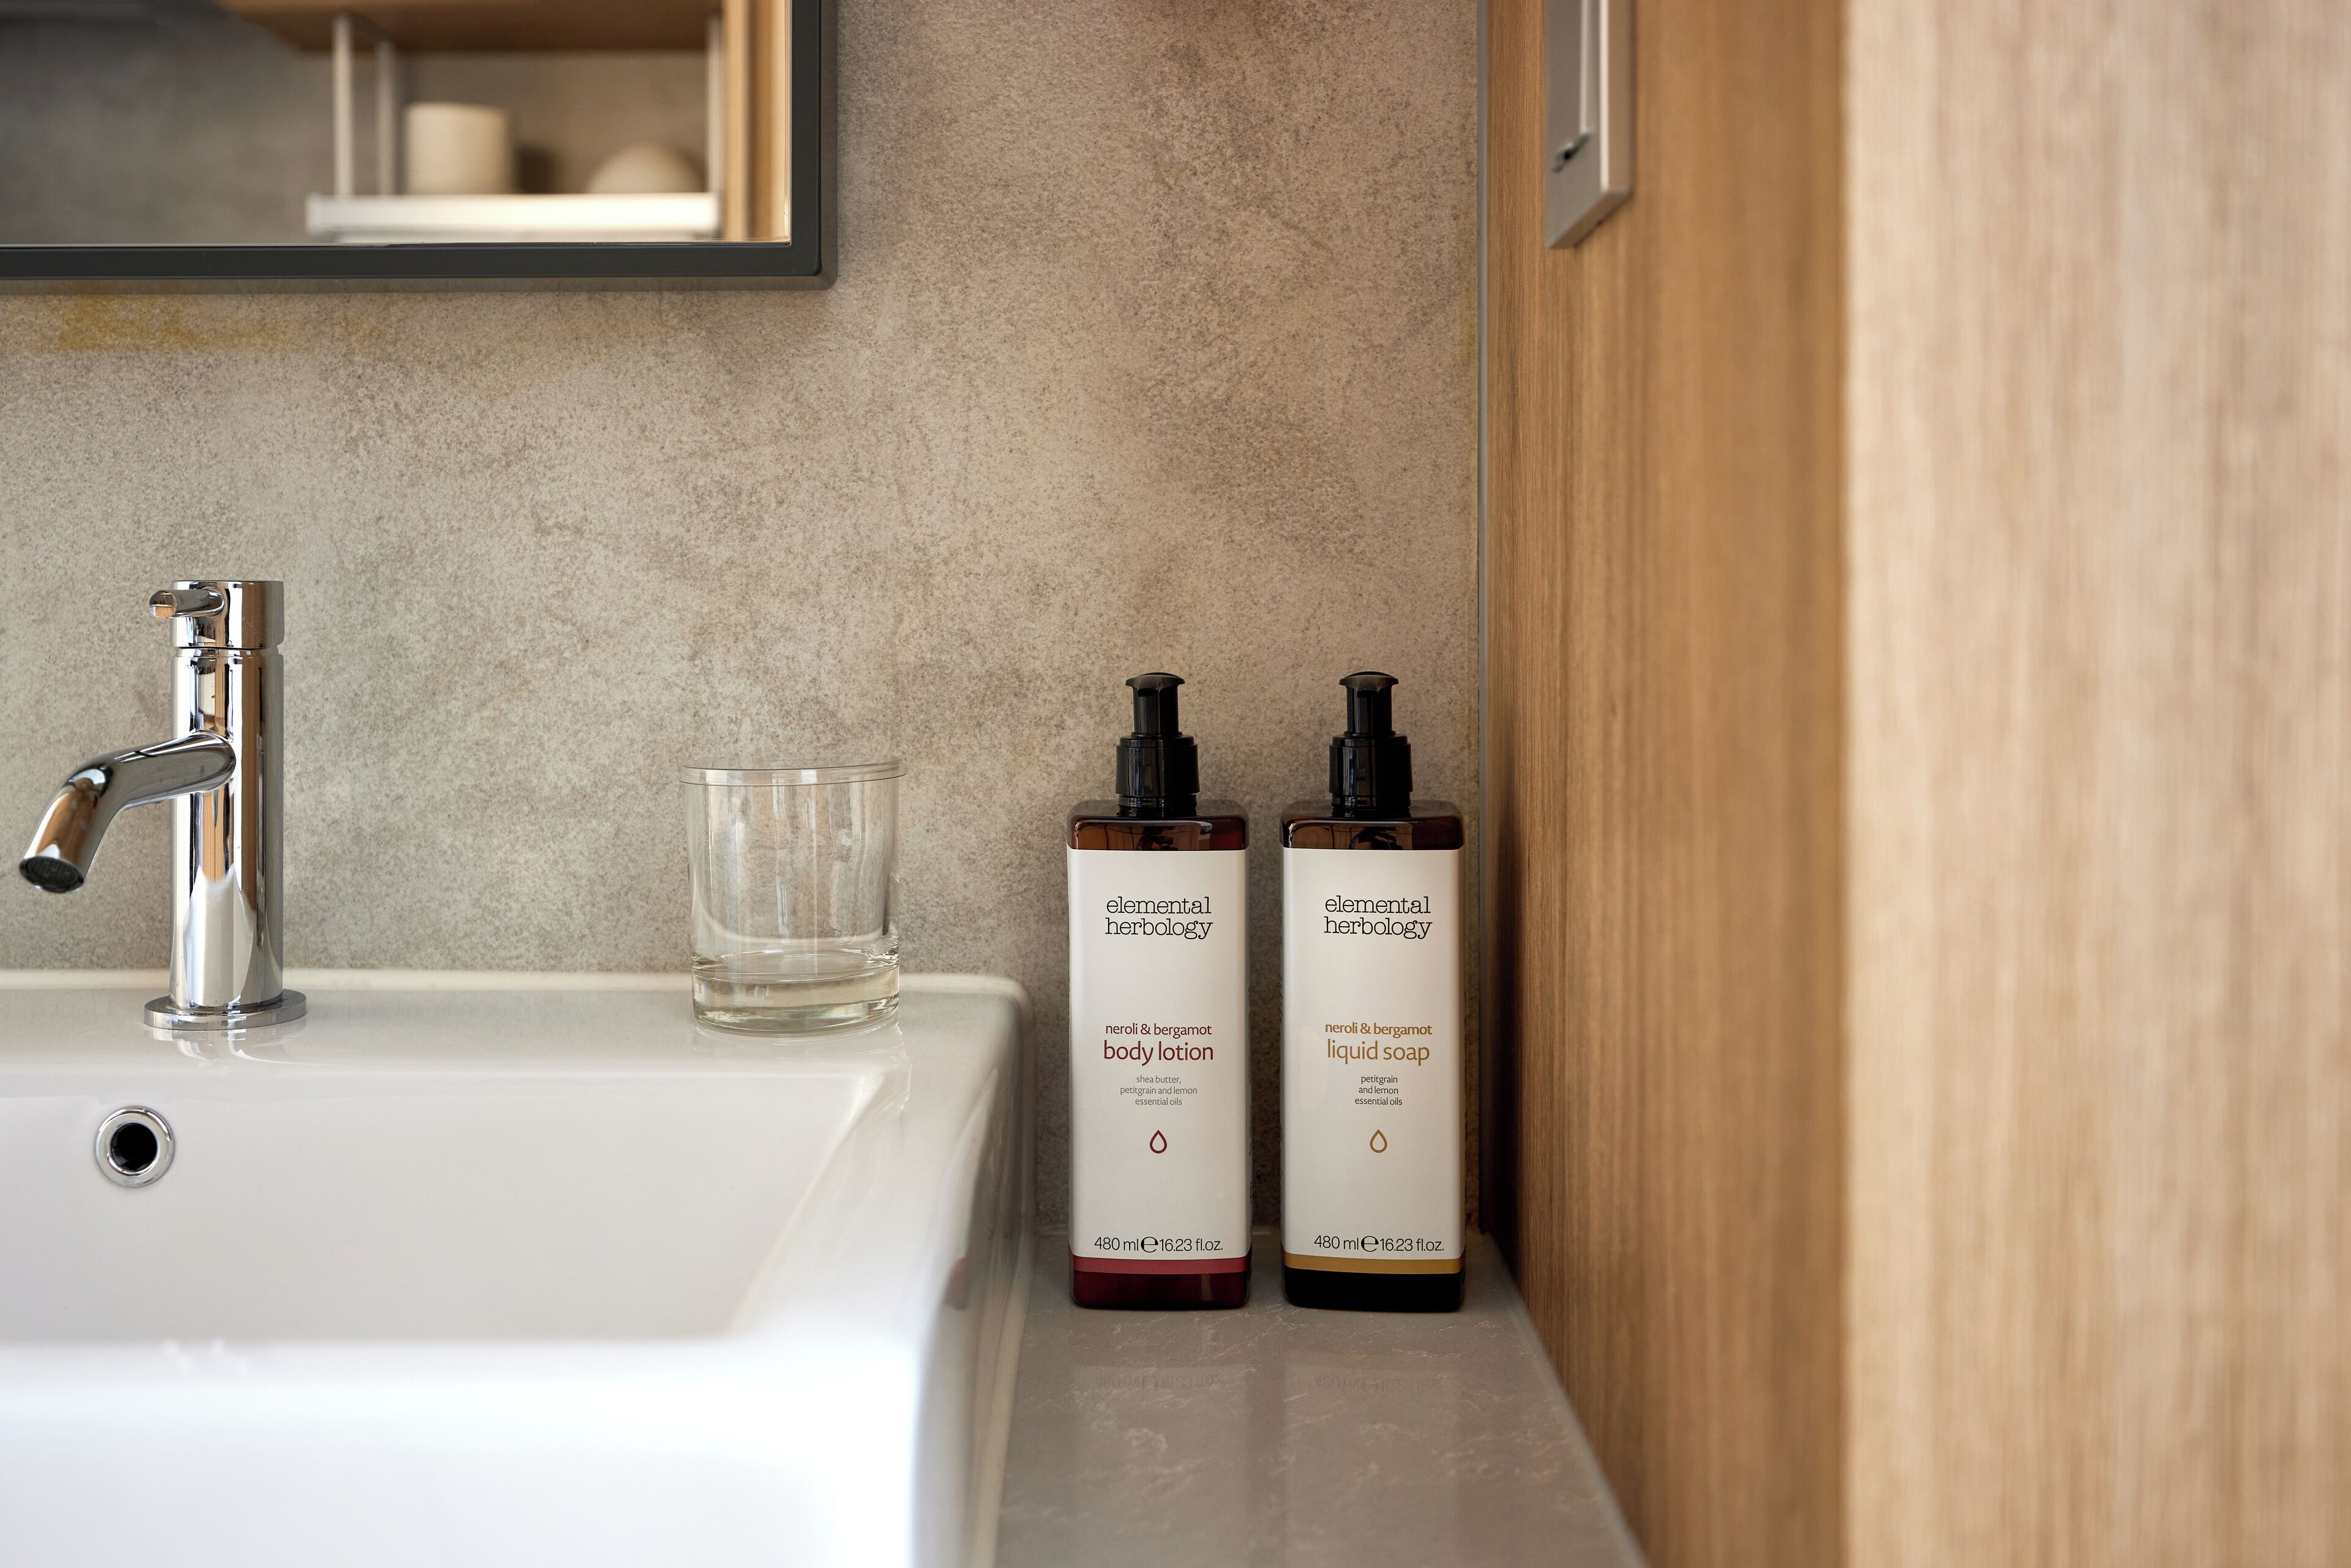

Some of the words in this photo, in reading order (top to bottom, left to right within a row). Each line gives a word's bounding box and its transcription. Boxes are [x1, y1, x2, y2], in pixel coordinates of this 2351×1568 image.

[1106, 896, 1212, 915] elemental
[1325, 895, 1431, 914] elemental
[1104, 917, 1214, 940] herbology
[1323, 915, 1433, 940] herbology
[1105, 1022, 1138, 1035] neroli
[1140, 1023, 1152, 1035] &
[1153, 1022, 1213, 1040] bergamot
[1325, 1021, 1358, 1034] neroli
[1359, 1022, 1371, 1035] &
[1373, 1022, 1433, 1039] bergamot
[1103, 1039, 1154, 1067] body
[1158, 1040, 1213, 1061] lotion
[1327, 1038, 1378, 1065] liquid
[1382, 1046, 1430, 1067] soap
[1136, 1074, 1154, 1083] shea
[1155, 1075, 1182, 1085] butter,
[1361, 1075, 1398, 1086] petitgrain
[1120, 1086, 1157, 1097] petitgrain
[1157, 1086, 1172, 1095] and
[1173, 1086, 1198, 1095] lemon
[1358, 1086, 1373, 1094] and
[1374, 1086, 1399, 1095] lemon
[1134, 1097, 1168, 1106] essential
[1169, 1097, 1182, 1106] oils
[1354, 1097, 1389, 1105] essential
[1389, 1097, 1403, 1106] oils
[1093, 1236, 1120, 1251] 480
[1313, 1235, 1340, 1250] 480
